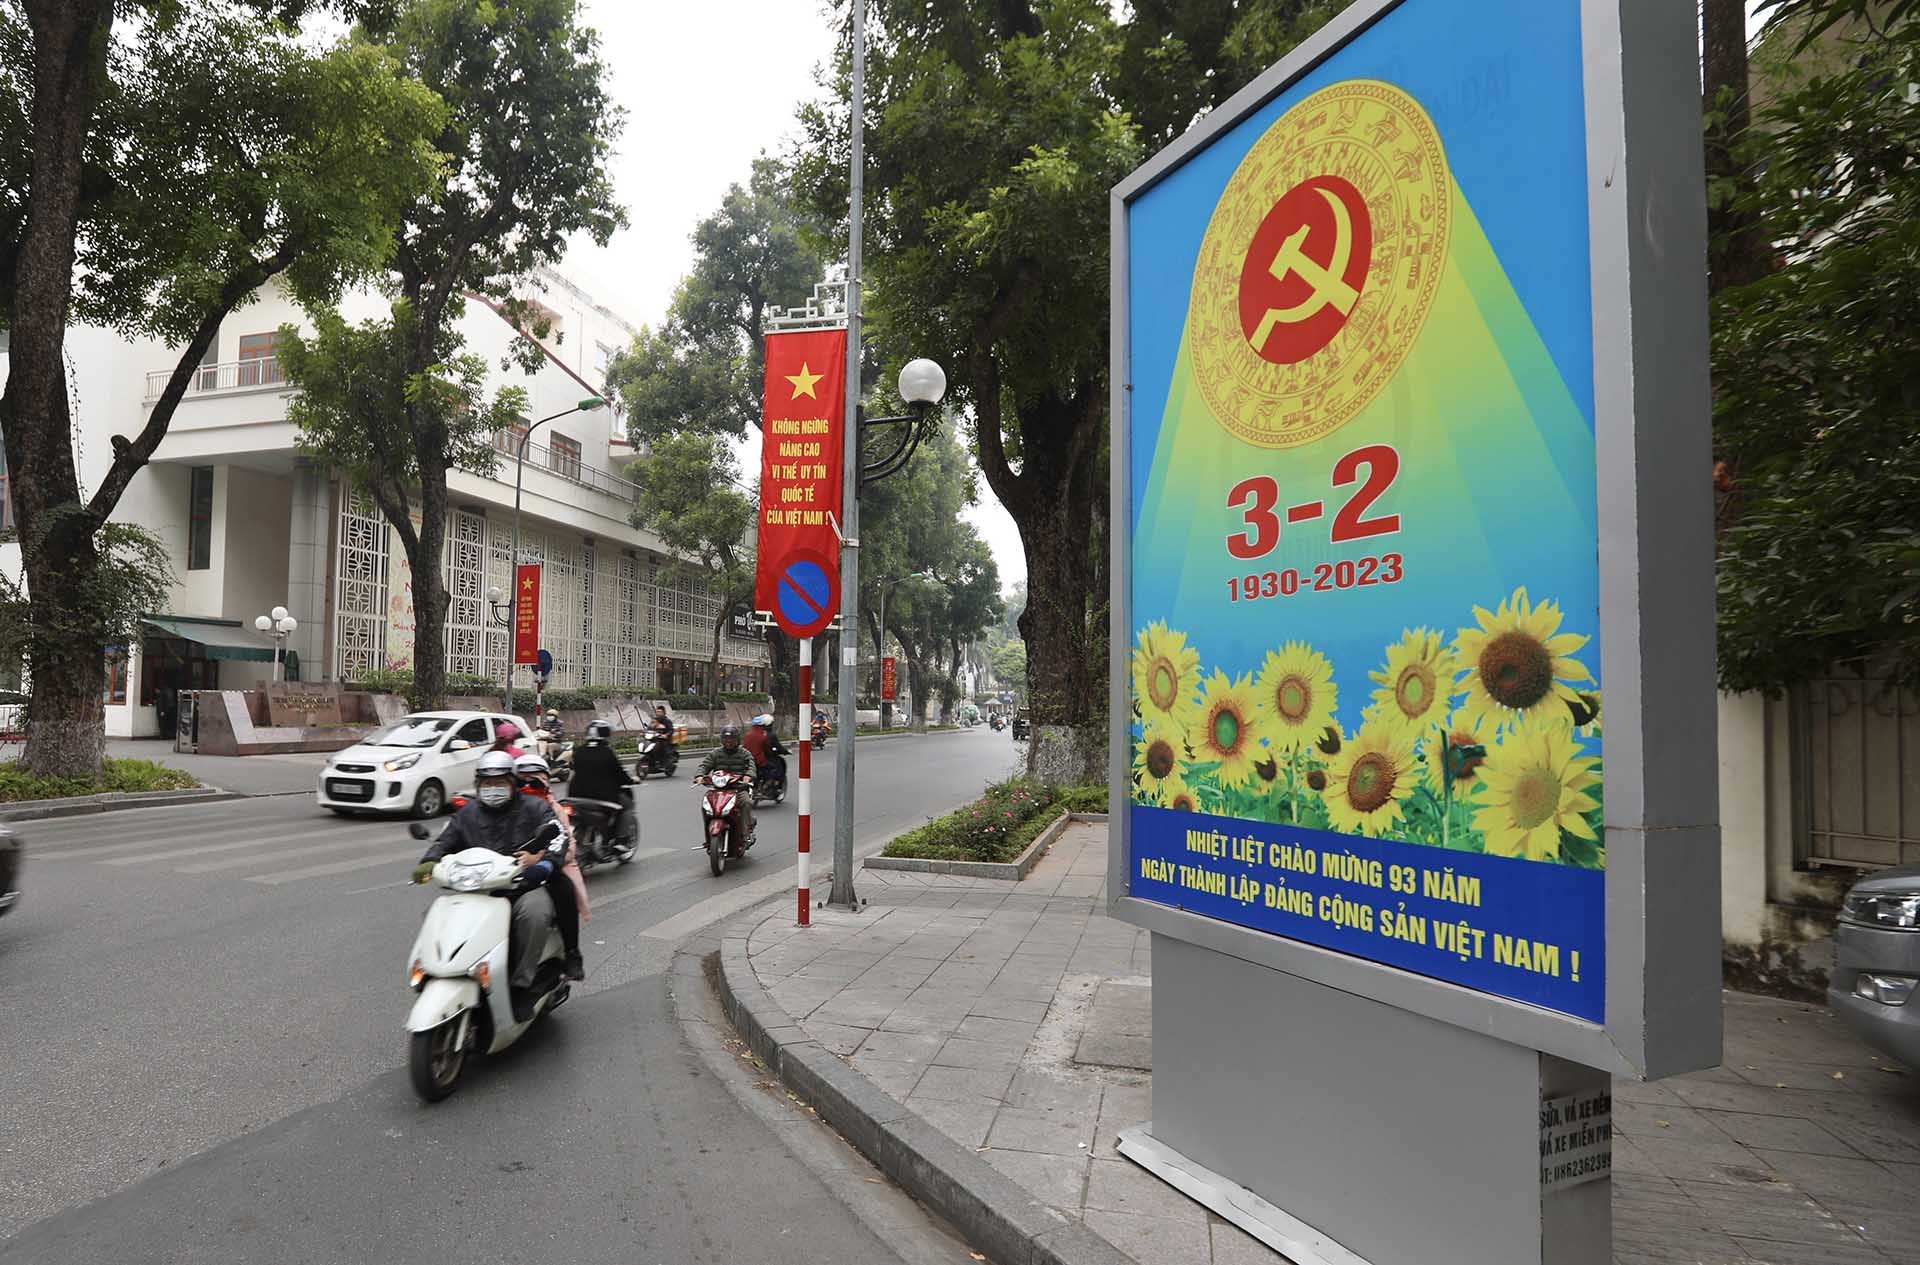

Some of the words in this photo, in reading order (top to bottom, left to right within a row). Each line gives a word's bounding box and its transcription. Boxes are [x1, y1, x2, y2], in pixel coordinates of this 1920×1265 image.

[772, 417, 800, 434] KHÔNG
[801, 416, 829, 434] NGỪNG
[780, 440, 802, 457] NÂNG
[804, 442, 820, 457] CAO
[772, 464, 780, 482] VỊ
[782, 460, 798, 480] THẾ
[800, 464, 811, 480] UY
[813, 461, 827, 480] TÍN
[781, 483, 803, 503] QUỐC
[804, 483, 816, 502] TẾ
[1226, 444, 1401, 560] 3-2
[767, 504, 783, 525] CỦA
[785, 508, 802, 528] VIỆT
[803, 510, 823, 526] NAM
[1226, 552, 1404, 602] 1930-2023
[1186, 829, 1229, 860] NHIỆT
[1232, 835, 1265, 867] LIỆT
[1269, 842, 1317, 875] CHÀO
[1322, 849, 1383, 888] MỪNG
[1388, 864, 1416, 894] 93
[1423, 867, 1481, 907] NĂM
[1141, 857, 1176, 884] NGÀY
[1179, 865, 1226, 896] THÀNH
[1230, 874, 1260, 906] LẬP
[1264, 876, 1313, 917] ĐẢNG
[1318, 893, 1373, 932] CỘNG
[1379, 902, 1426, 945] SẢN
[1433, 920, 1486, 962] VIỆT
[1493, 933, 1560, 977] NAM
[1571, 950, 1580, 982] !
[1578, 1099, 1592, 1120] XE
[1554, 1134, 1567, 1155] XE
